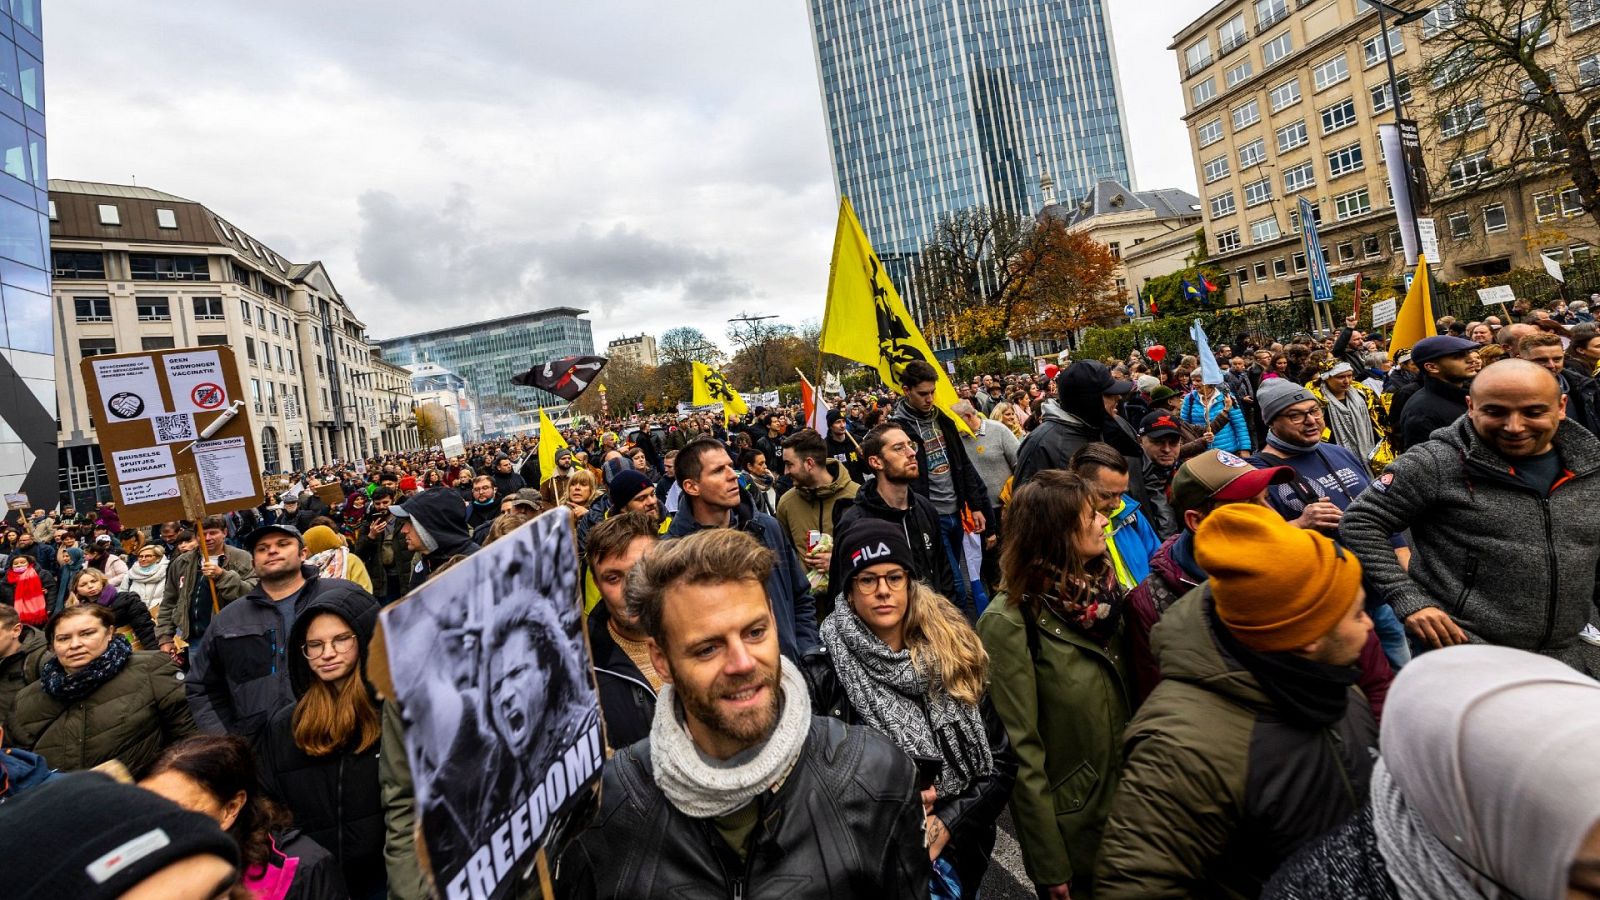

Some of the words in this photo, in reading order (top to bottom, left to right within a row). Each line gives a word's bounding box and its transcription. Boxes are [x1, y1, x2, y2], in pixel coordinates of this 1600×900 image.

[170, 361, 215, 370] GEDWONGEN
[172, 368, 214, 377] VACCINATIE
[118, 451, 161, 461] BRUSSELSE
[120, 458, 155, 467] SPUITJES
[121, 463, 167, 474] MENUKAART
[851, 542, 891, 568] FILA
[445, 723, 603, 900] FREEDOM!
